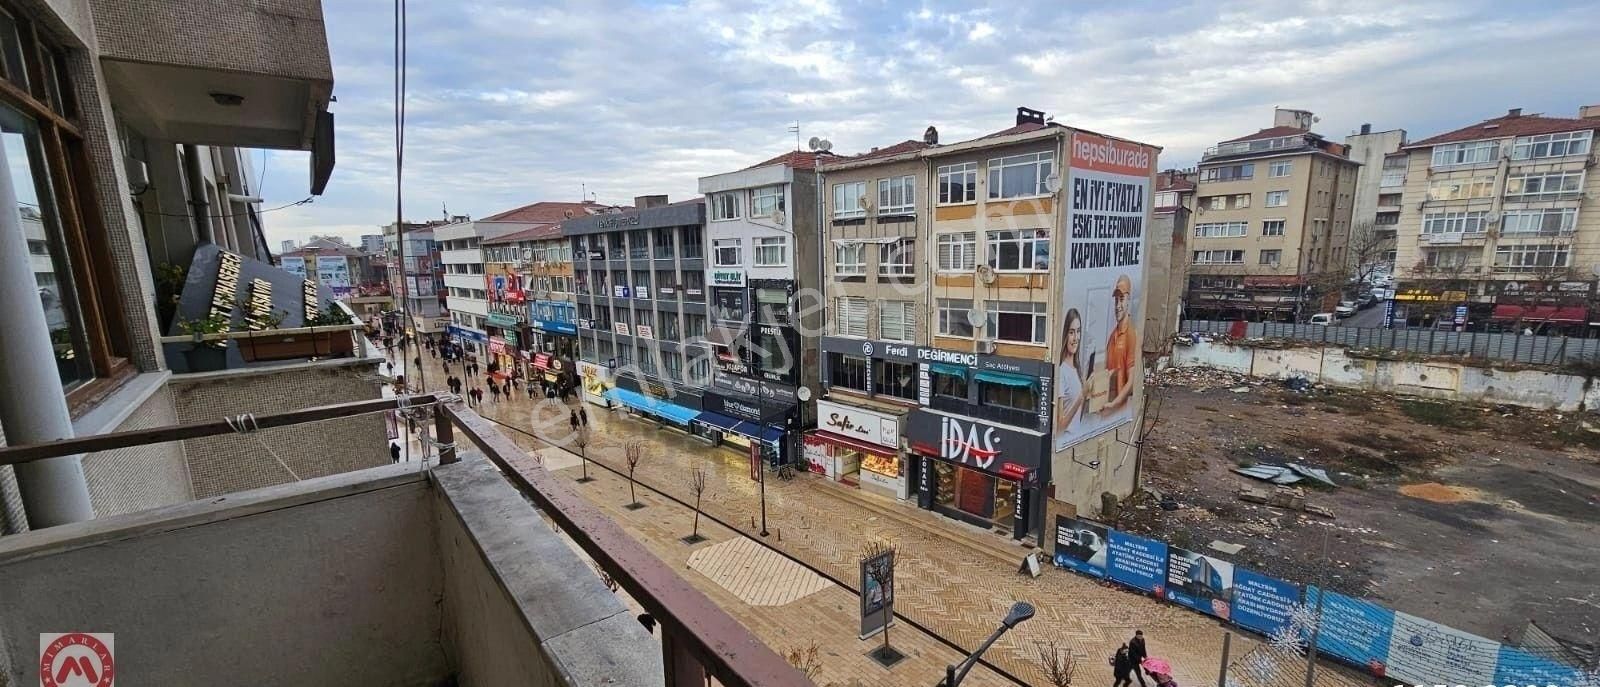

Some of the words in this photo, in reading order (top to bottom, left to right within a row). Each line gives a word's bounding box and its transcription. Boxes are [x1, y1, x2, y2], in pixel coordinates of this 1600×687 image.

[1072, 133, 1149, 168] hepsiburada
[1073, 177, 1088, 210] EN
[1089, 179, 1105, 211] İYİ
[1106, 181, 1142, 213] FİYATLA
[1072, 213, 1092, 239] ESKİ
[1093, 214, 1143, 239] TELEFONUNU
[1070, 242, 1111, 269] KAPINDA
[1113, 241, 1140, 267] YENİLE
[885, 345, 908, 357] Ferdi
[917, 347, 978, 367] DEĞİRMENCİ
[826, 412, 854, 431] Safir
